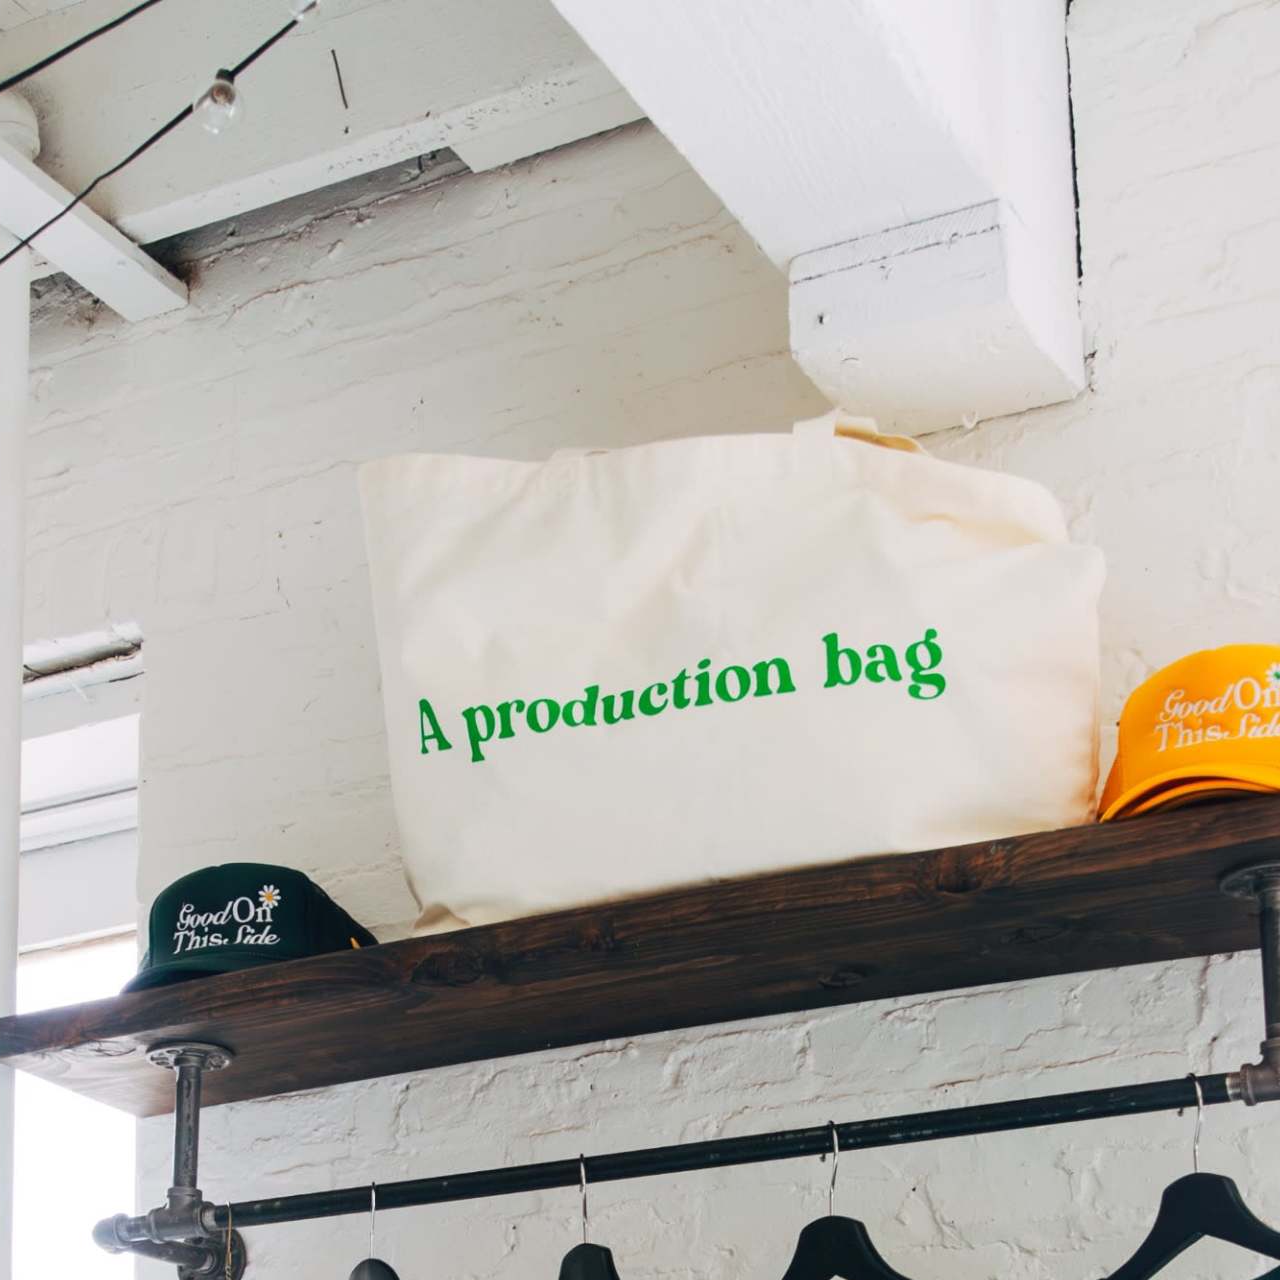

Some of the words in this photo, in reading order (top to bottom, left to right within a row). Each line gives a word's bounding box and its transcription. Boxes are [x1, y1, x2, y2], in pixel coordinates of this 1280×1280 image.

[418, 697, 452, 755] A
[461, 656, 798, 764] production
[821, 627, 949, 702] bag
[1158, 683, 1234, 721] Good
[1153, 718, 1223, 752] This
[176, 900, 233, 931] Good
[233, 896, 273, 923] On
[173, 927, 223, 954] This
[230, 925, 281, 945] Side
